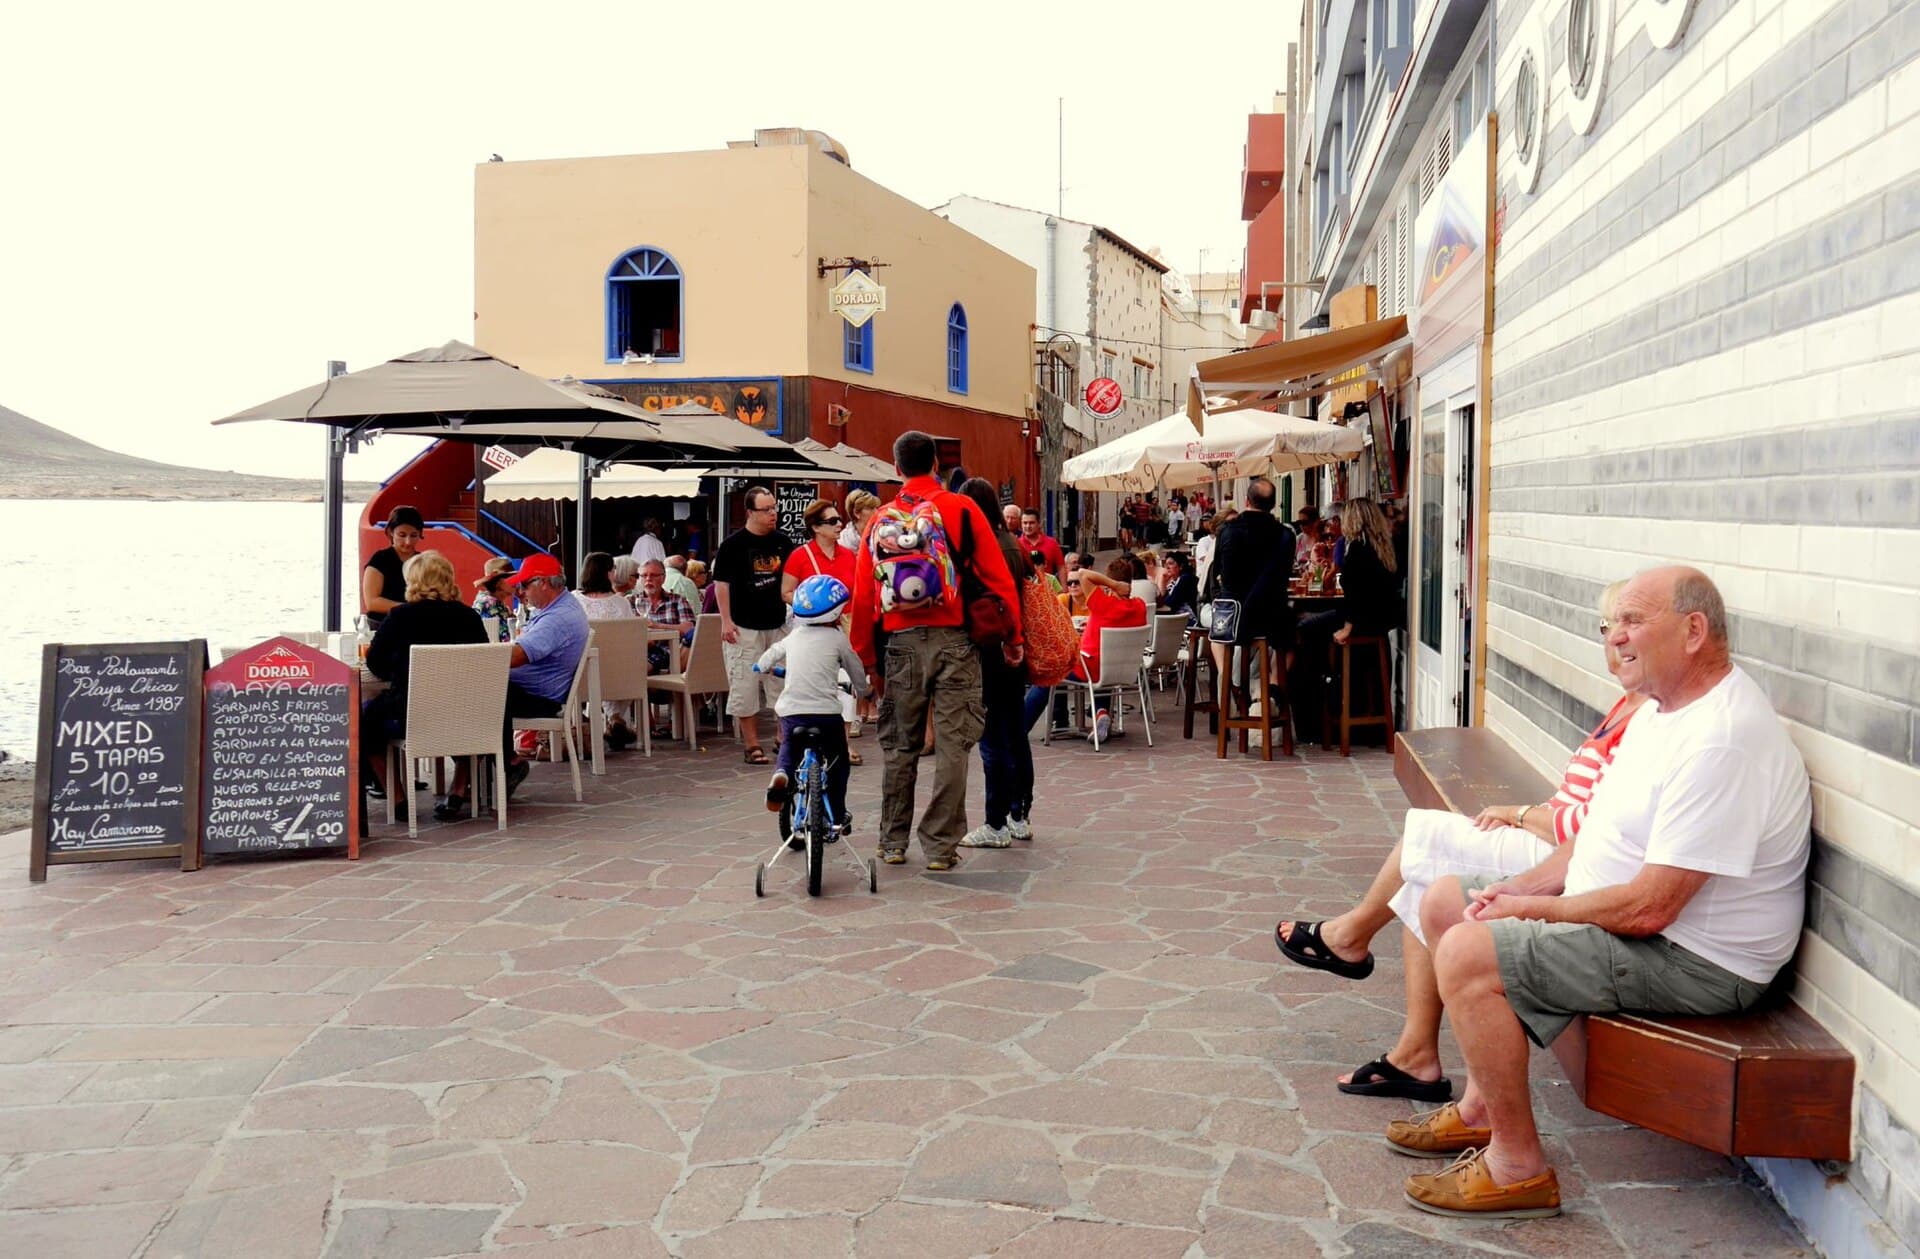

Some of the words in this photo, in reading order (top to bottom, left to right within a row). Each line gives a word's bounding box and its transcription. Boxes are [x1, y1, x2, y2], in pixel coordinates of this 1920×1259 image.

[835, 293, 880, 305] DORADA
[58, 658, 92, 676] Bar
[248, 665, 310, 678] DORADA
[68, 676, 125, 707] Playa
[130, 676, 179, 694] Chica
[144, 696, 185, 711] 1987
[212, 700, 280, 715] SARDINAS
[286, 700, 329, 711] FRITAS
[56, 720, 153, 748] MIXED
[213, 725, 258, 739] ATUN
[262, 725, 286, 735] CON
[211, 737, 276, 751] SARDINAS
[279, 738, 288, 748] A
[68, 751, 89, 774] 5
[95, 746, 165, 769] TAPAS
[213, 751, 256, 764] PULPO
[259, 753, 281, 765] EN
[213, 783, 259, 796] HUEVOS
[264, 780, 322, 792] RELLENOS
[211, 796, 273, 810] BOQUERONES
[209, 809, 280, 823] CHIPIRONES
[51, 817, 86, 847] Hay
[88, 813, 166, 839] Camarones
[206, 824, 257, 840] PAELLA
